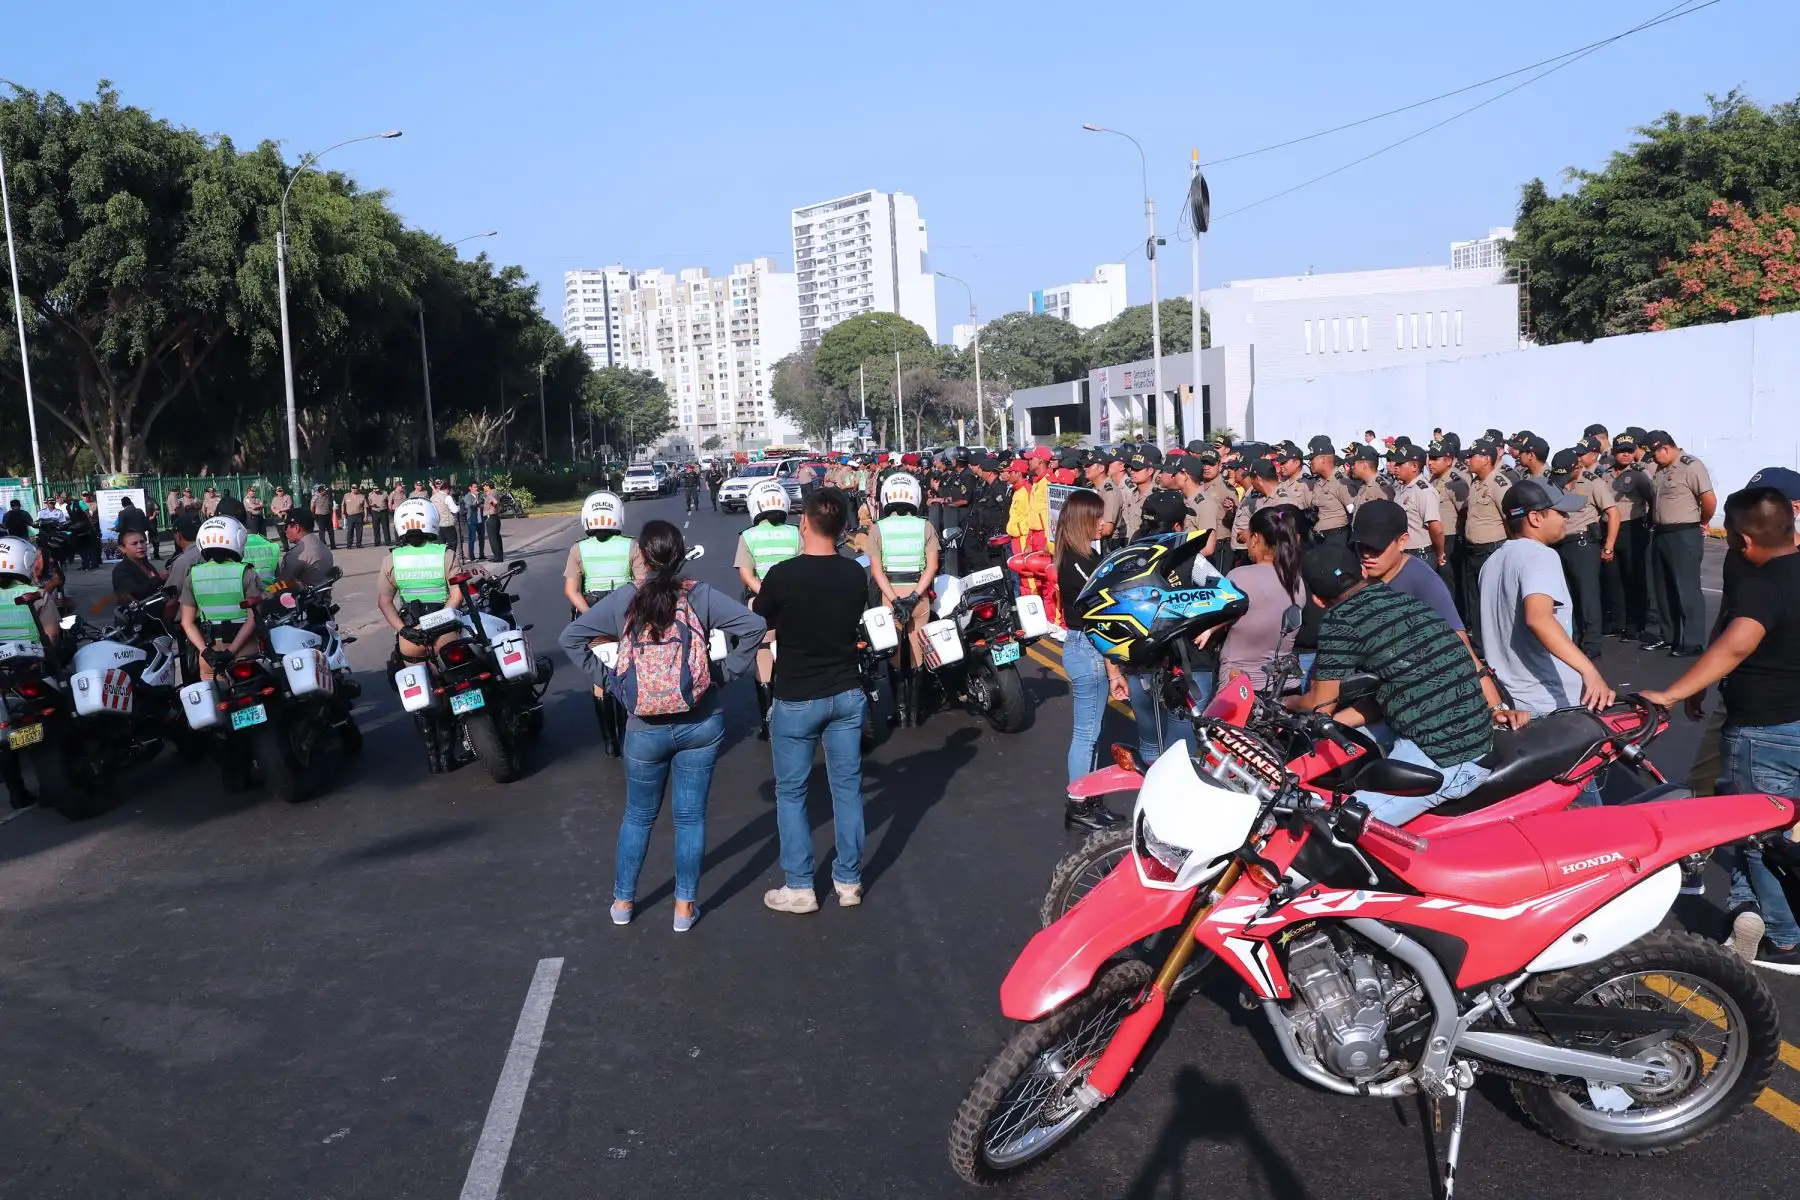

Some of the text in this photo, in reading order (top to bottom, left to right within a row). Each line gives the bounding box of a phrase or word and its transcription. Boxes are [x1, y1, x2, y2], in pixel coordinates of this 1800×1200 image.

[890, 476, 912, 485] POLICIA
[760, 483, 782, 492] POLICIA
[203, 519, 227, 528] POLICIA
[1168, 590, 1216, 604] HOKEN
[104, 684, 132, 696] POLICIA
[1214, 725, 1282, 782] RENTHAL
[1561, 851, 1624, 875] HONDA
